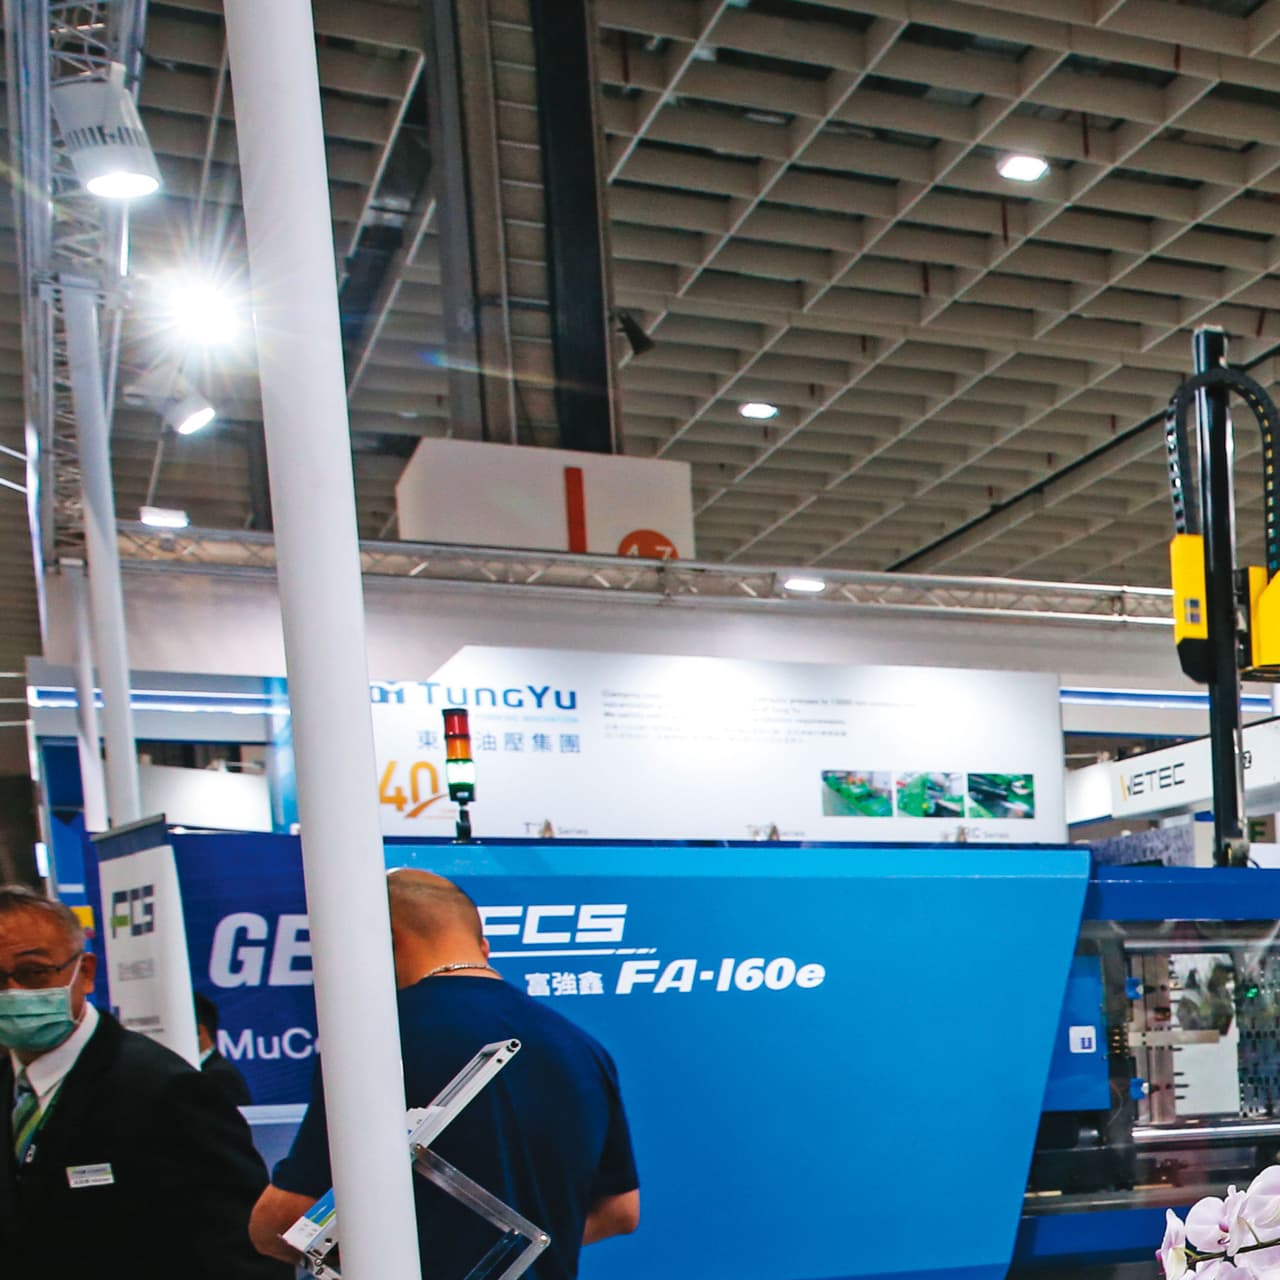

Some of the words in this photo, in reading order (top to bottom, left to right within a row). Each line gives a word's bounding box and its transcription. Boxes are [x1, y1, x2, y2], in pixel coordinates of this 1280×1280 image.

[1120, 762, 1185, 800] WETEC
[477, 904, 628, 944] FCS
[525, 970, 605, 997] 富強鑫
[615, 956, 826, 995] FA-160e
